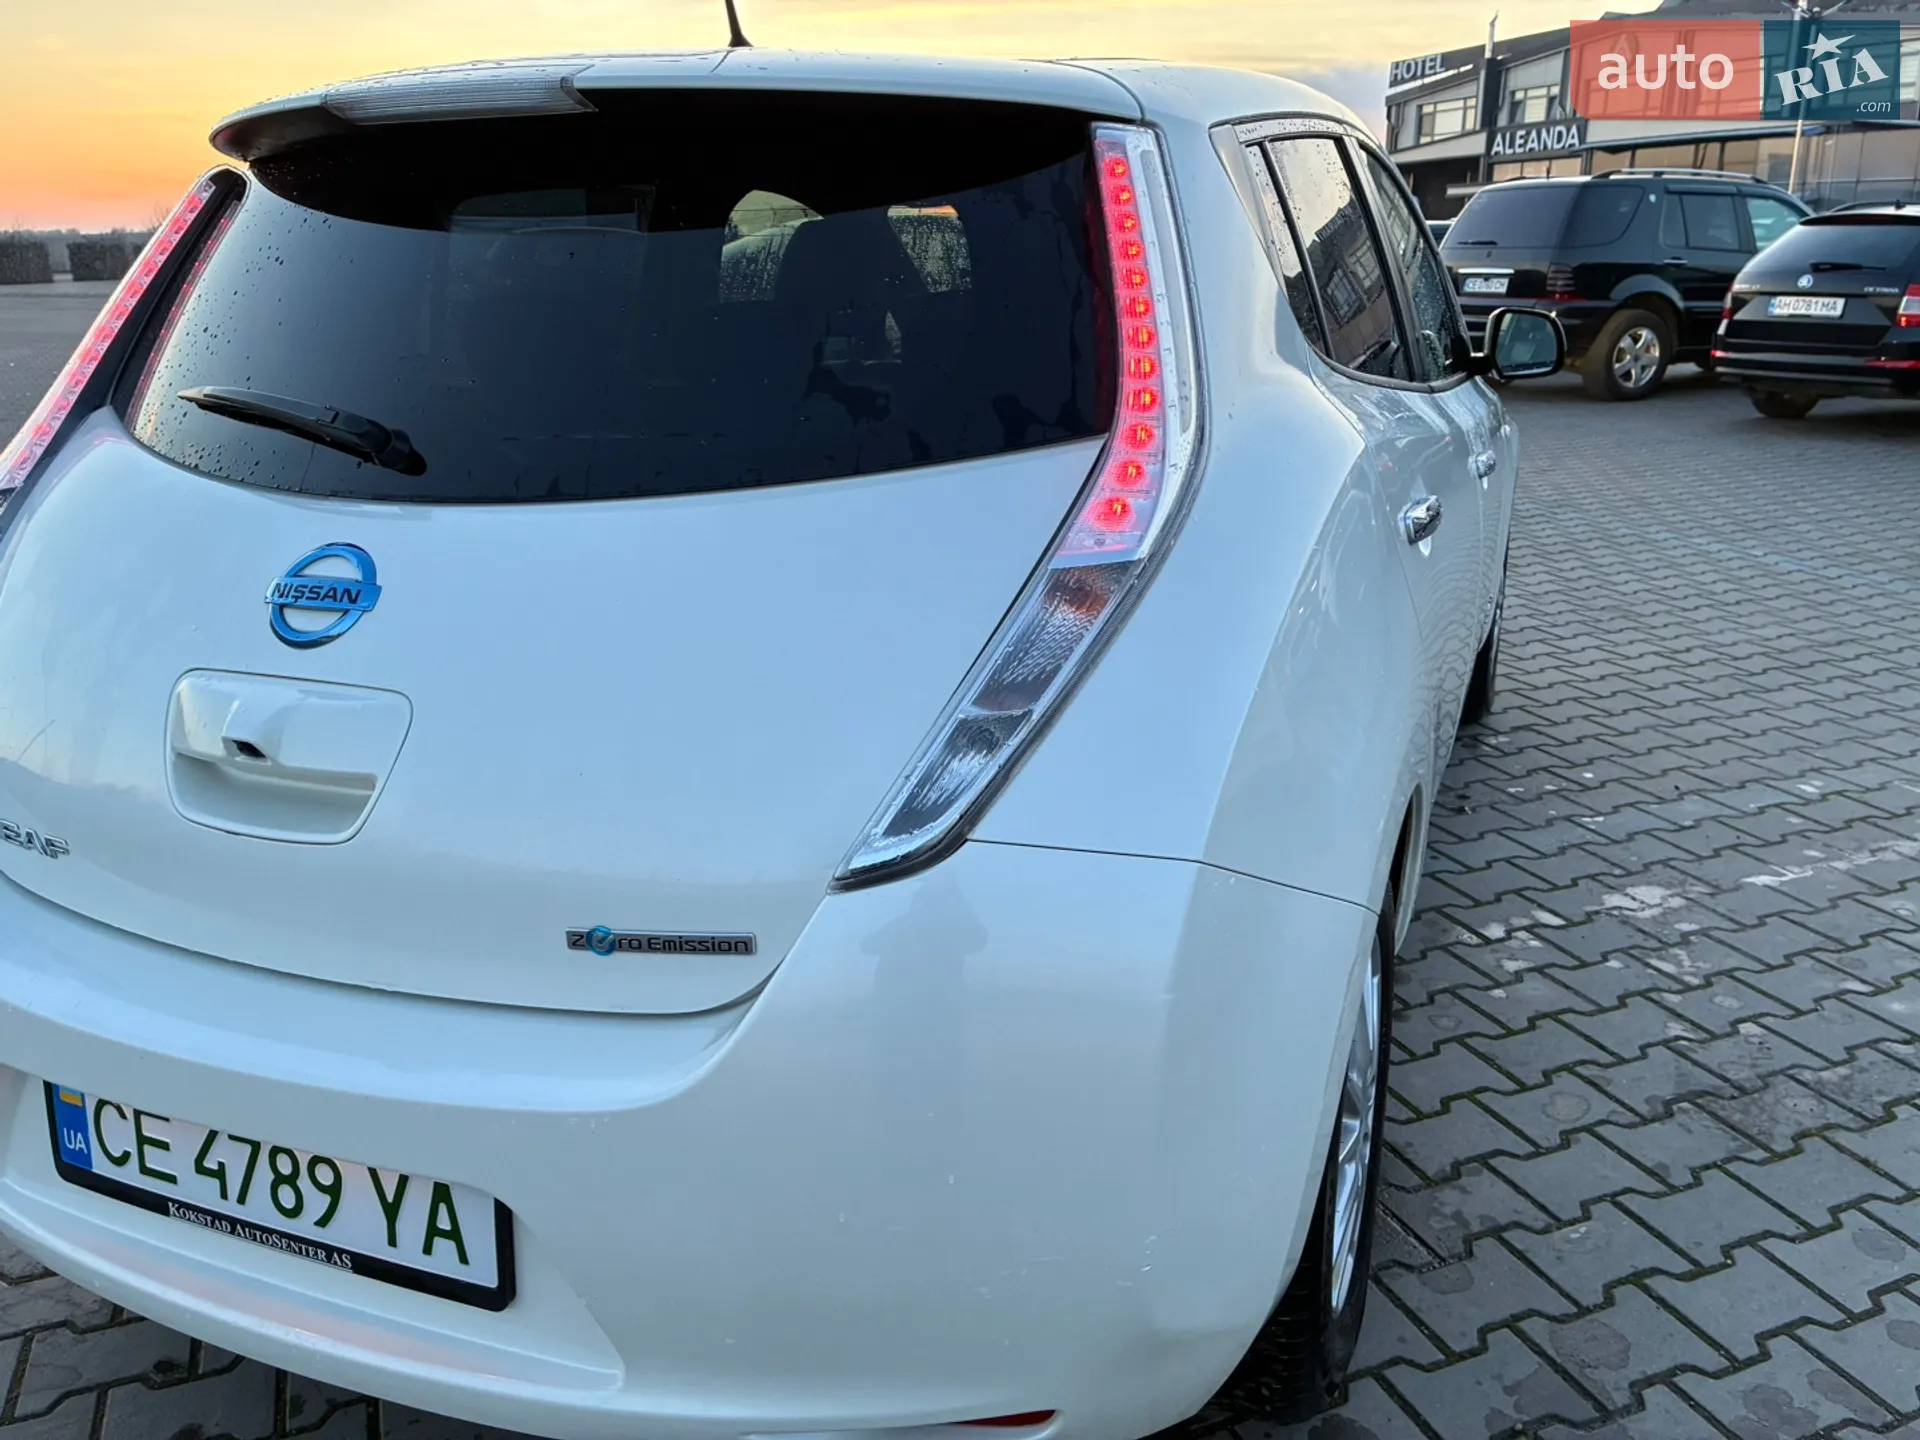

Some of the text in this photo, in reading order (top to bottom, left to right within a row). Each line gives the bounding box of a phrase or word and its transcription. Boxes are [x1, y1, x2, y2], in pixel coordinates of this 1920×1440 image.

[1390, 53, 1446, 81] HOTEL
[1490, 123, 1580, 156] ALEANDA
[1776, 299, 1838, 313] AH 0781 MA
[270, 582, 363, 605] NISSAN
[647, 936, 750, 952] Emission
[62, 1127, 88, 1154] UA
[93, 1097, 470, 1266] CE 4789 YA
[330, 1250, 353, 1270] AS
